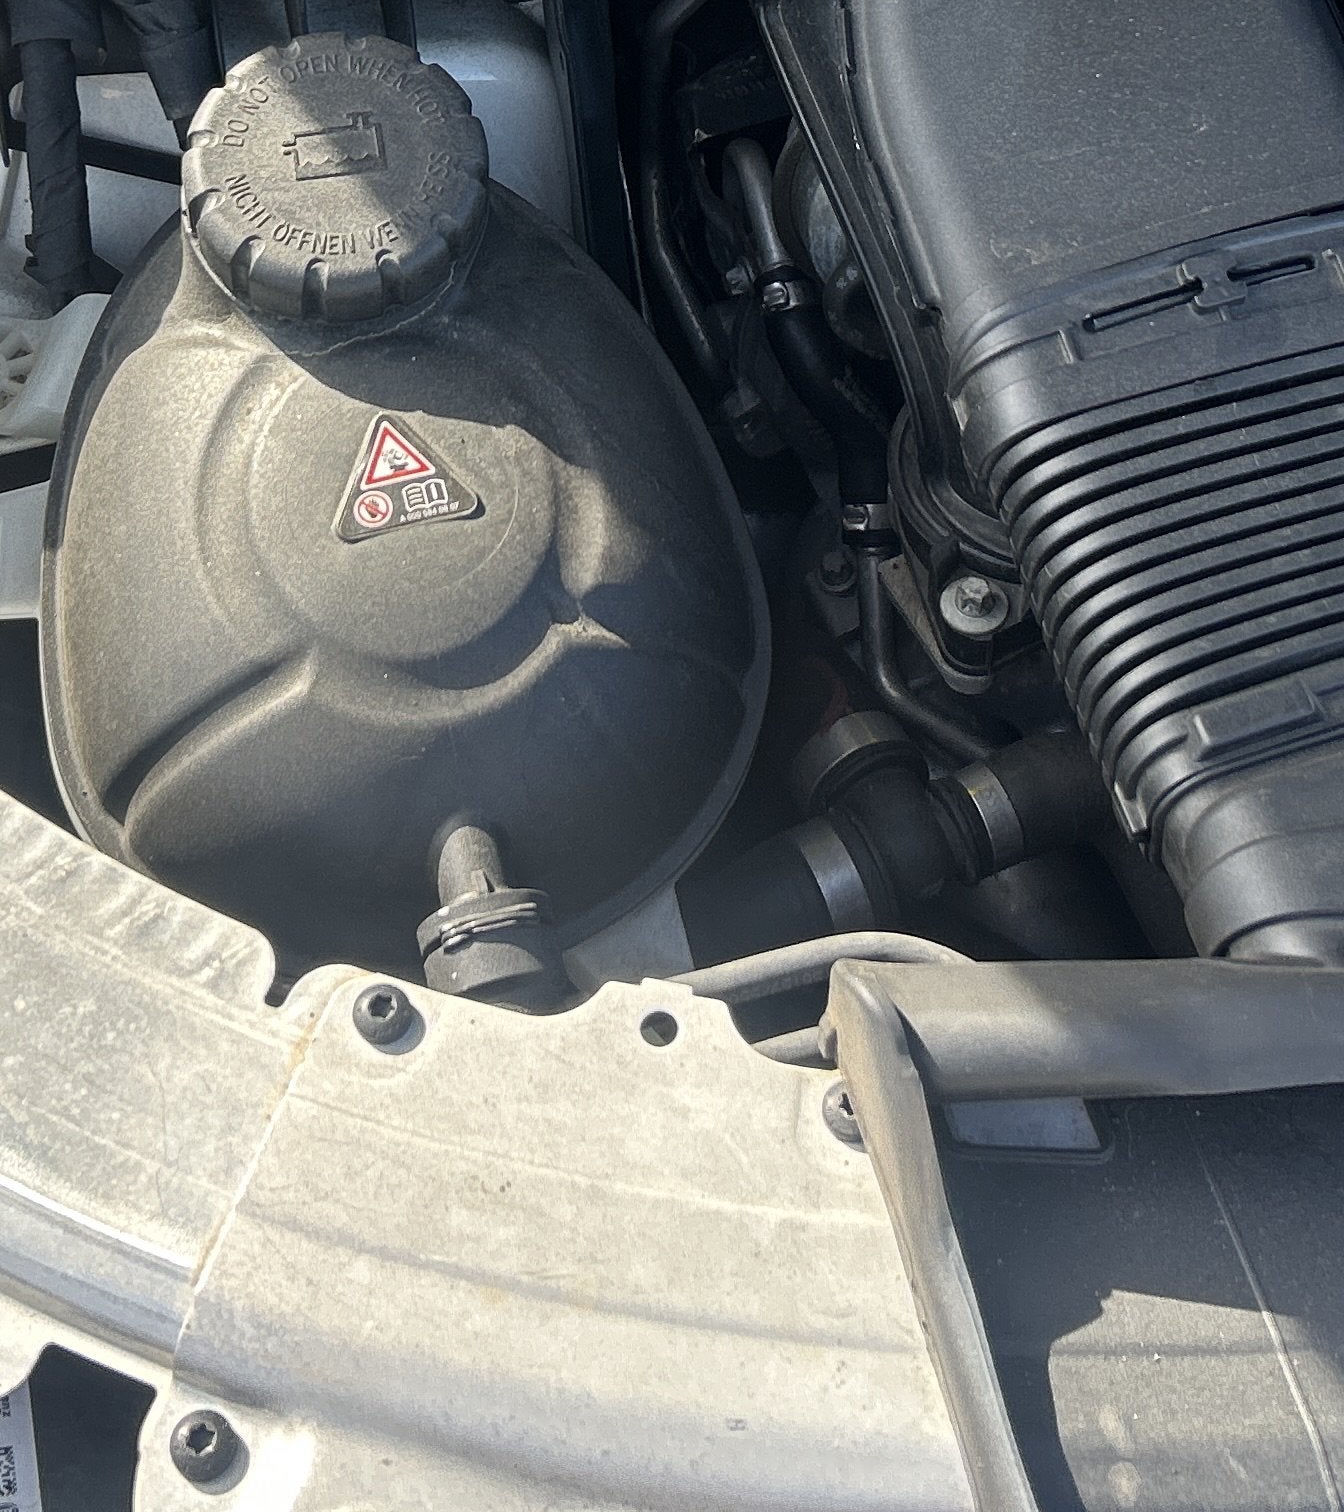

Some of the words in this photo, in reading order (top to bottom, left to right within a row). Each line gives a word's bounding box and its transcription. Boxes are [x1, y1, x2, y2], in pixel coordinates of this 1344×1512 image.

[221, 118, 249, 148] DO
[279, 54, 339, 83] OPEN
[347, 55, 409, 92] WHEN
[224, 173, 275, 229] NICHT
